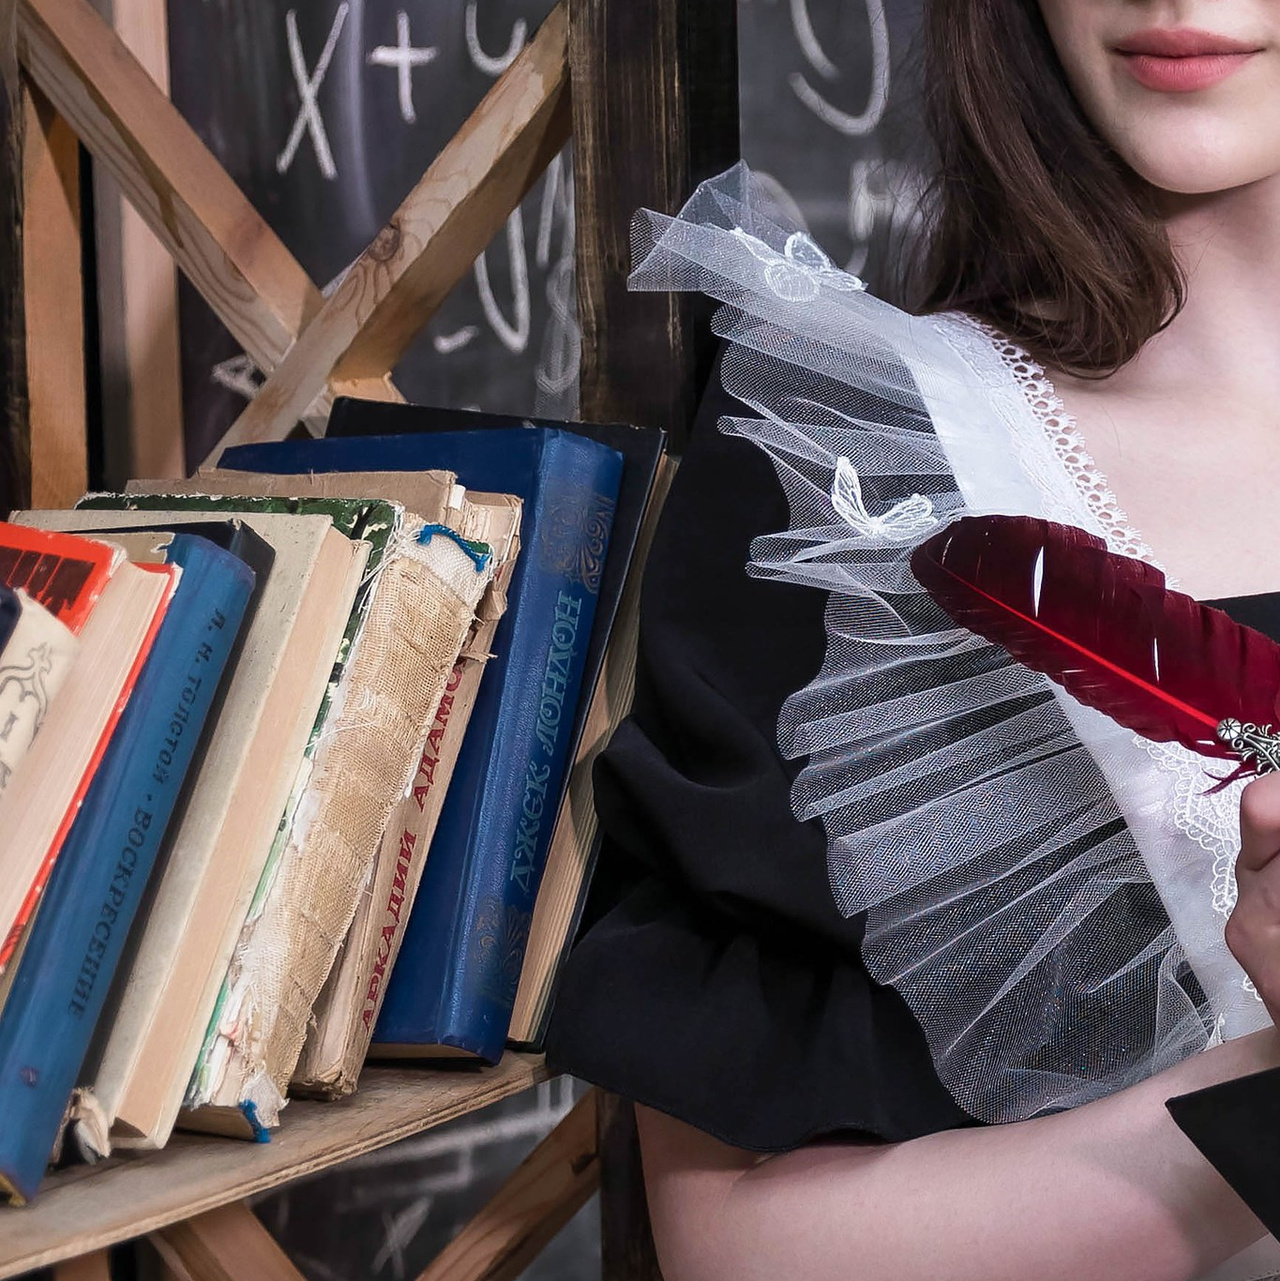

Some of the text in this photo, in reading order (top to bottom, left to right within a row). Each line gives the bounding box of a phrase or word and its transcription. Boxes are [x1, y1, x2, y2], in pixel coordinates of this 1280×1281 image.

[154, 676, 203, 785] ТОЛСТОЙ
[361, 663, 465, 1034] АРКАДИЙ АДАМО
[510, 589, 583, 897] ДЖЕК ЛОНДОН
[68, 807, 154, 1021] ВОСКРЕСЕНИЕ
